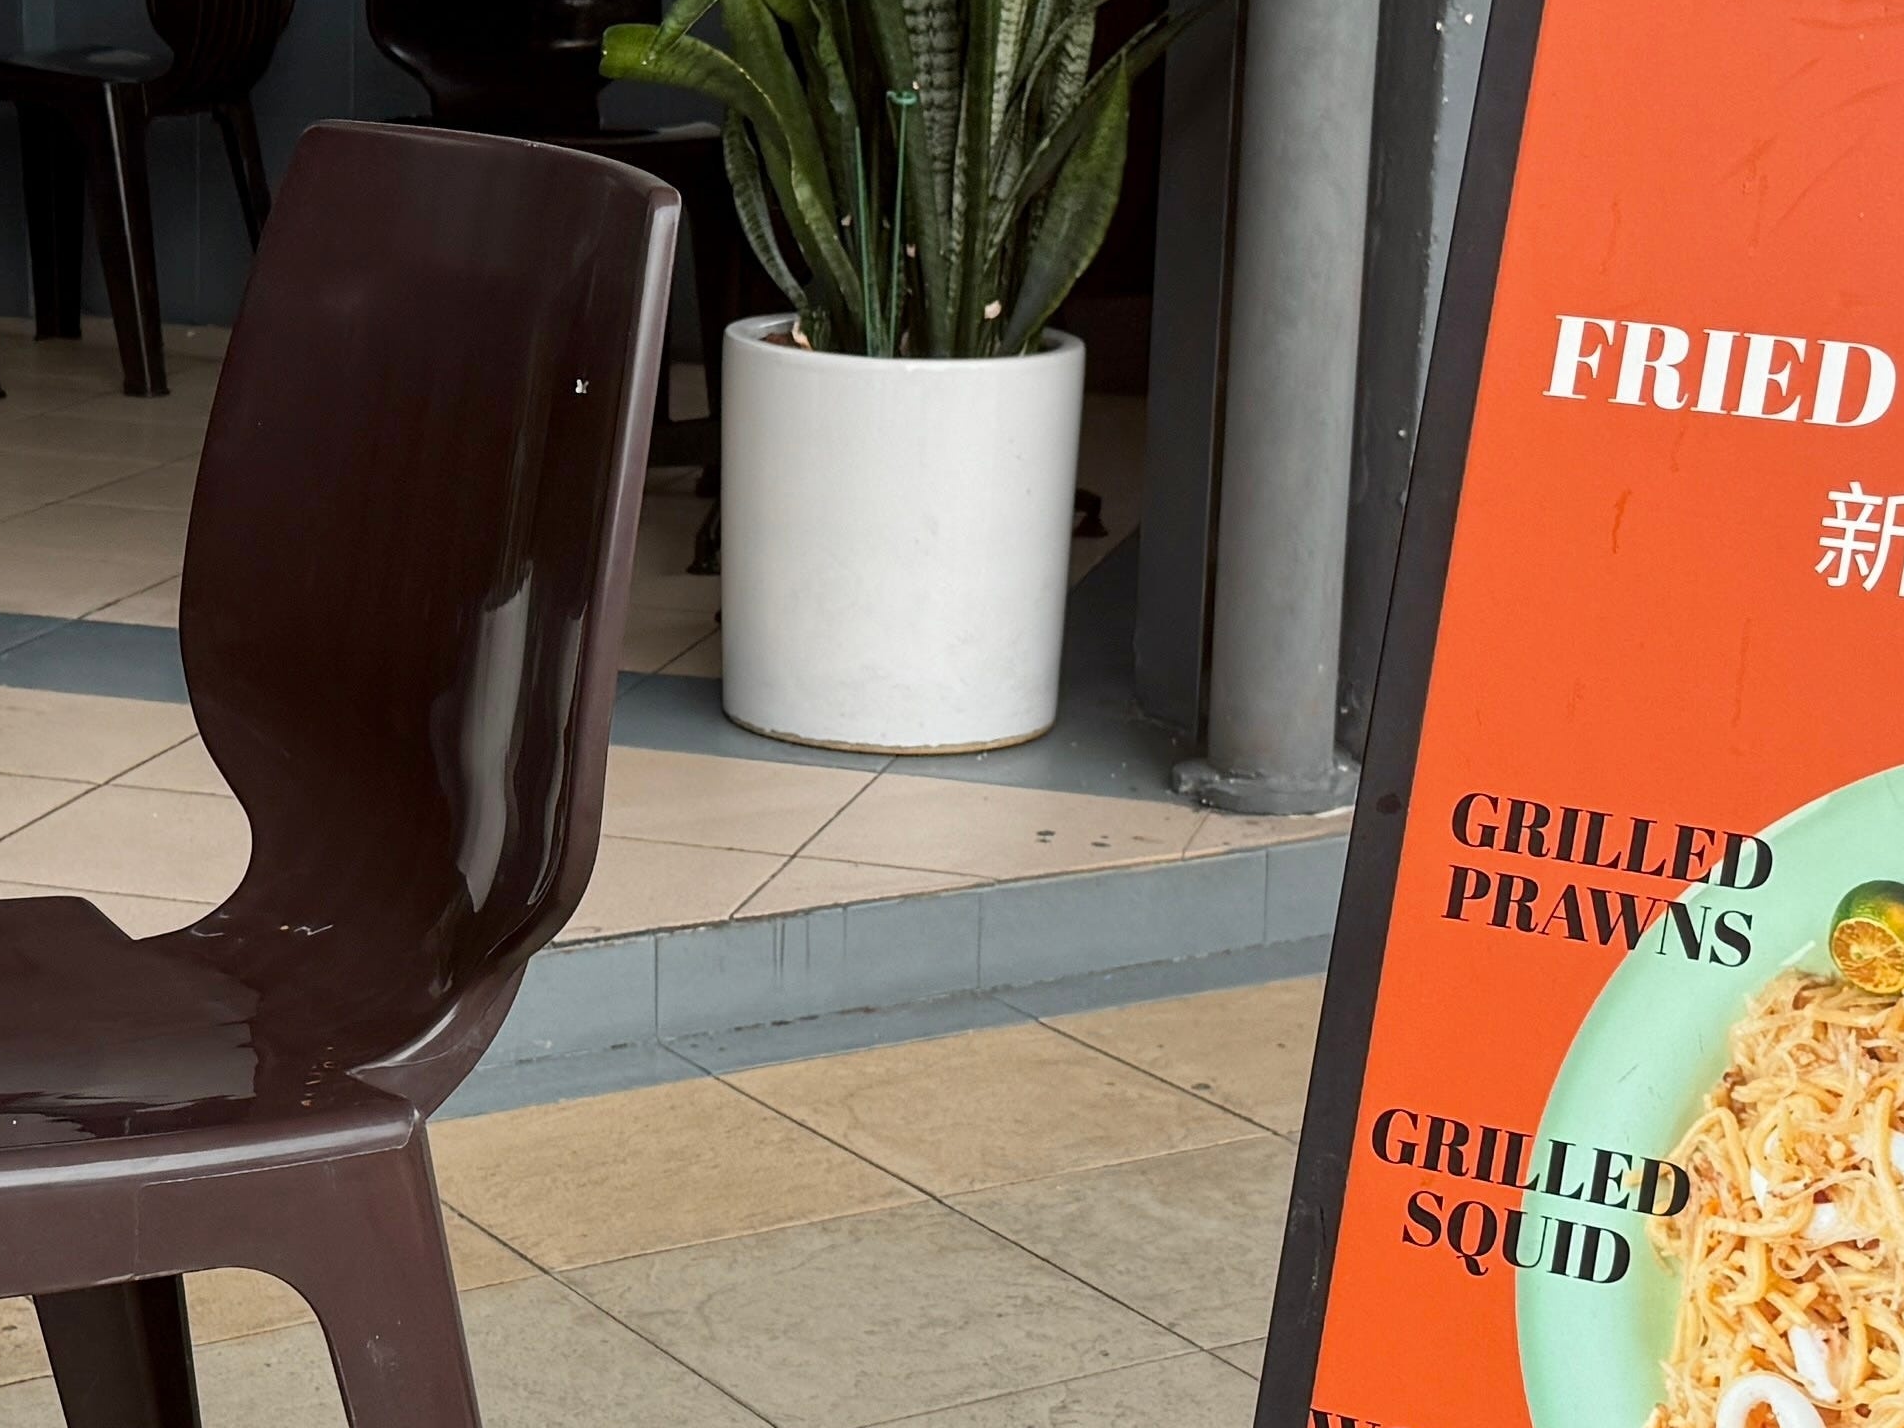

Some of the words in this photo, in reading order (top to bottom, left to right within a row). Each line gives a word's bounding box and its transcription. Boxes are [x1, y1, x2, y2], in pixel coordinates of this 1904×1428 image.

[1542, 313, 1898, 428] FRIED
[1451, 791, 1774, 891] GRILLED
[1440, 864, 1755, 968] PRAWNS
[1371, 1108, 1691, 1219] GRILLED
[1401, 1190, 1632, 1285] SQUID
